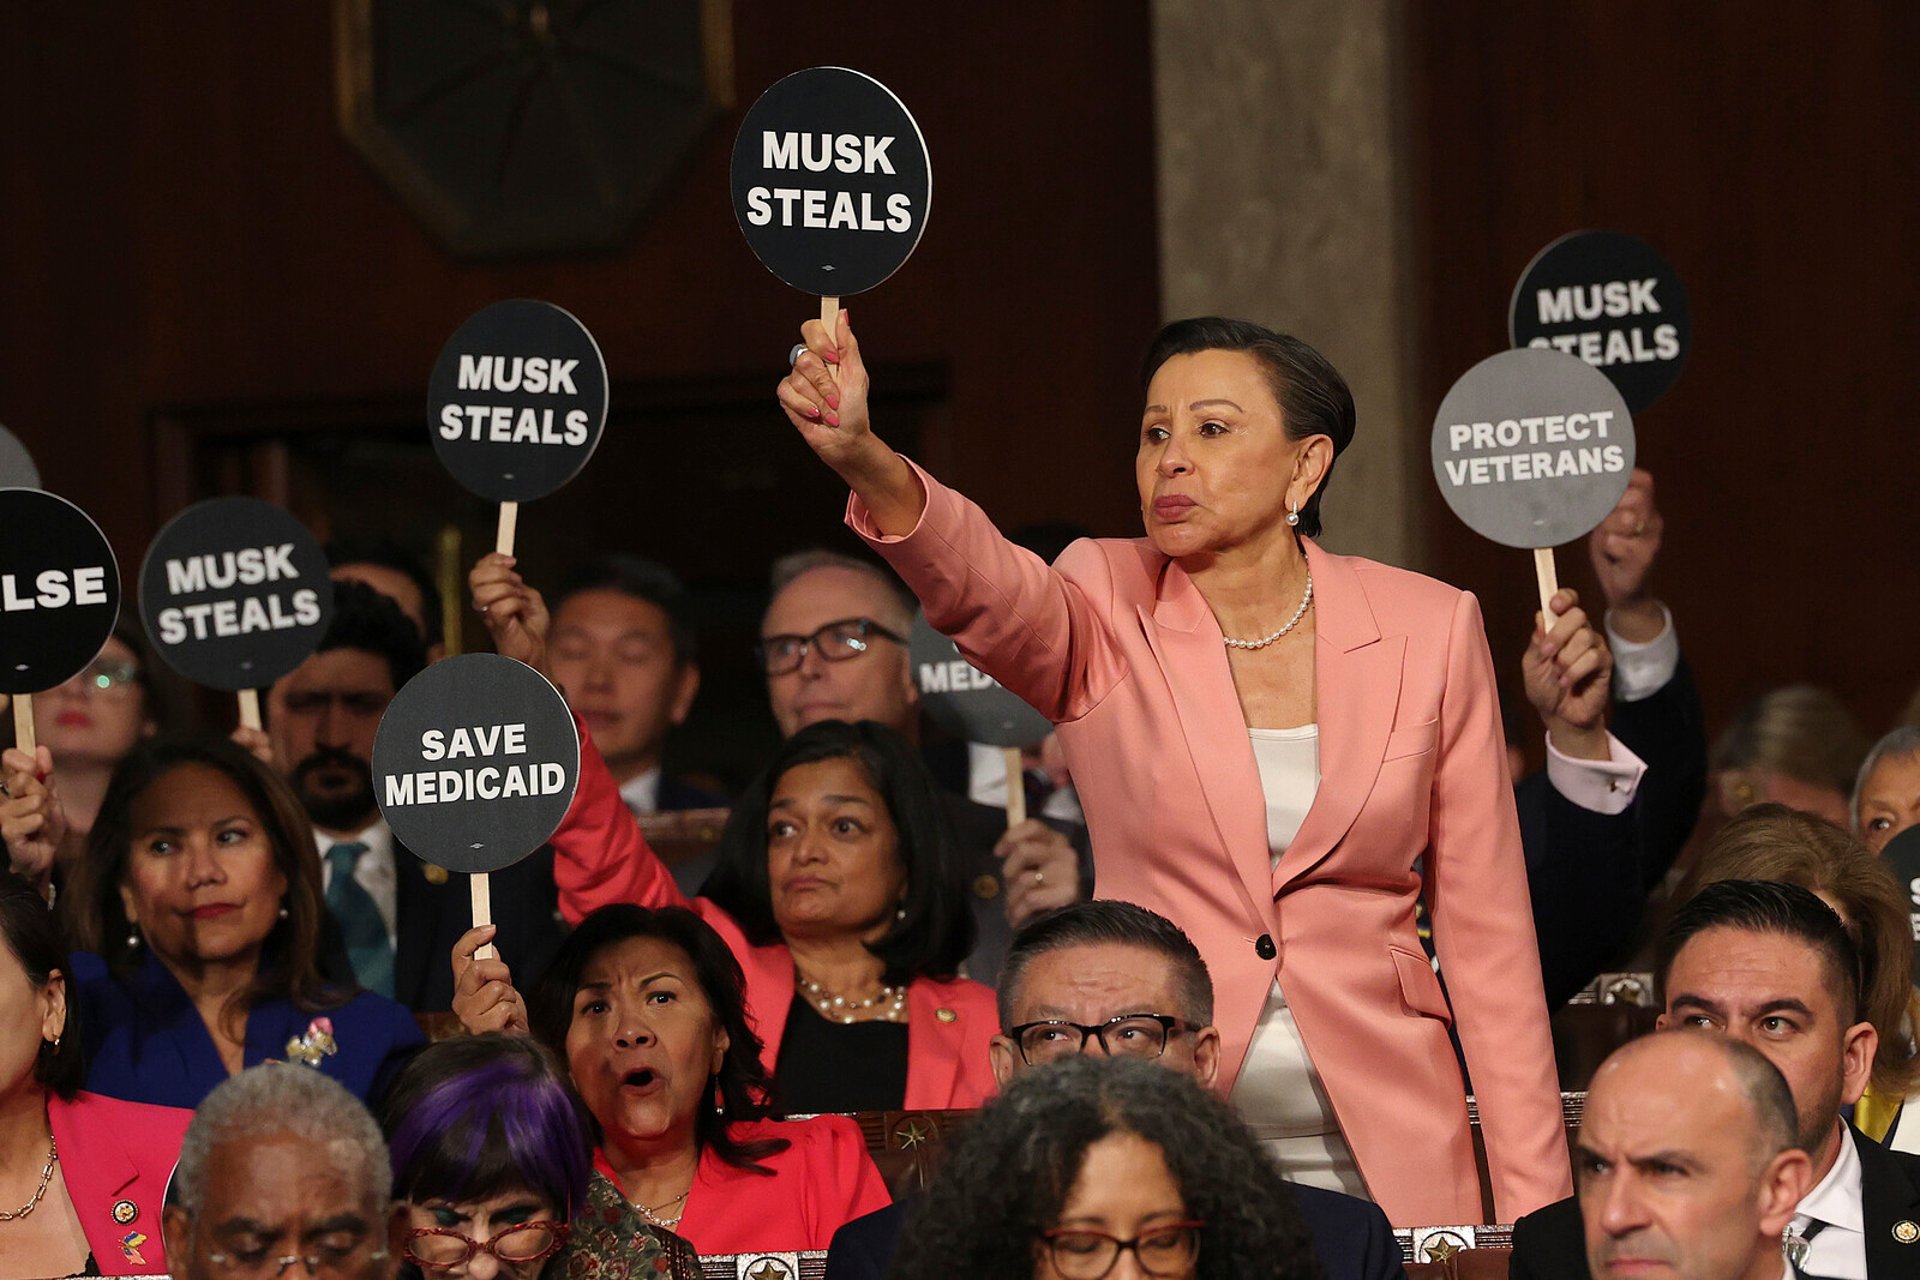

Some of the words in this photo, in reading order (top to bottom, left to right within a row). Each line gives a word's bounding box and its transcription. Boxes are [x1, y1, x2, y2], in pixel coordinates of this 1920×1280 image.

[762, 130, 897, 177] MUSK
[746, 186, 912, 233] STEALS
[1537, 278, 1662, 325] MUSK
[1527, 323, 1681, 367] TEALS
[457, 354, 580, 395] MUSK
[439, 403, 589, 446] STEALS
[1449, 410, 1614, 452] PROTECT
[1444, 445, 1626, 487] VETERANS
[0, 566, 108, 612] LSE
[166, 543, 300, 595] MUSK
[159, 589, 321, 645] STEALS
[919, 660, 1003, 694] MED
[421, 723, 527, 761] SAVE
[385, 762, 567, 807] MEDICAID
